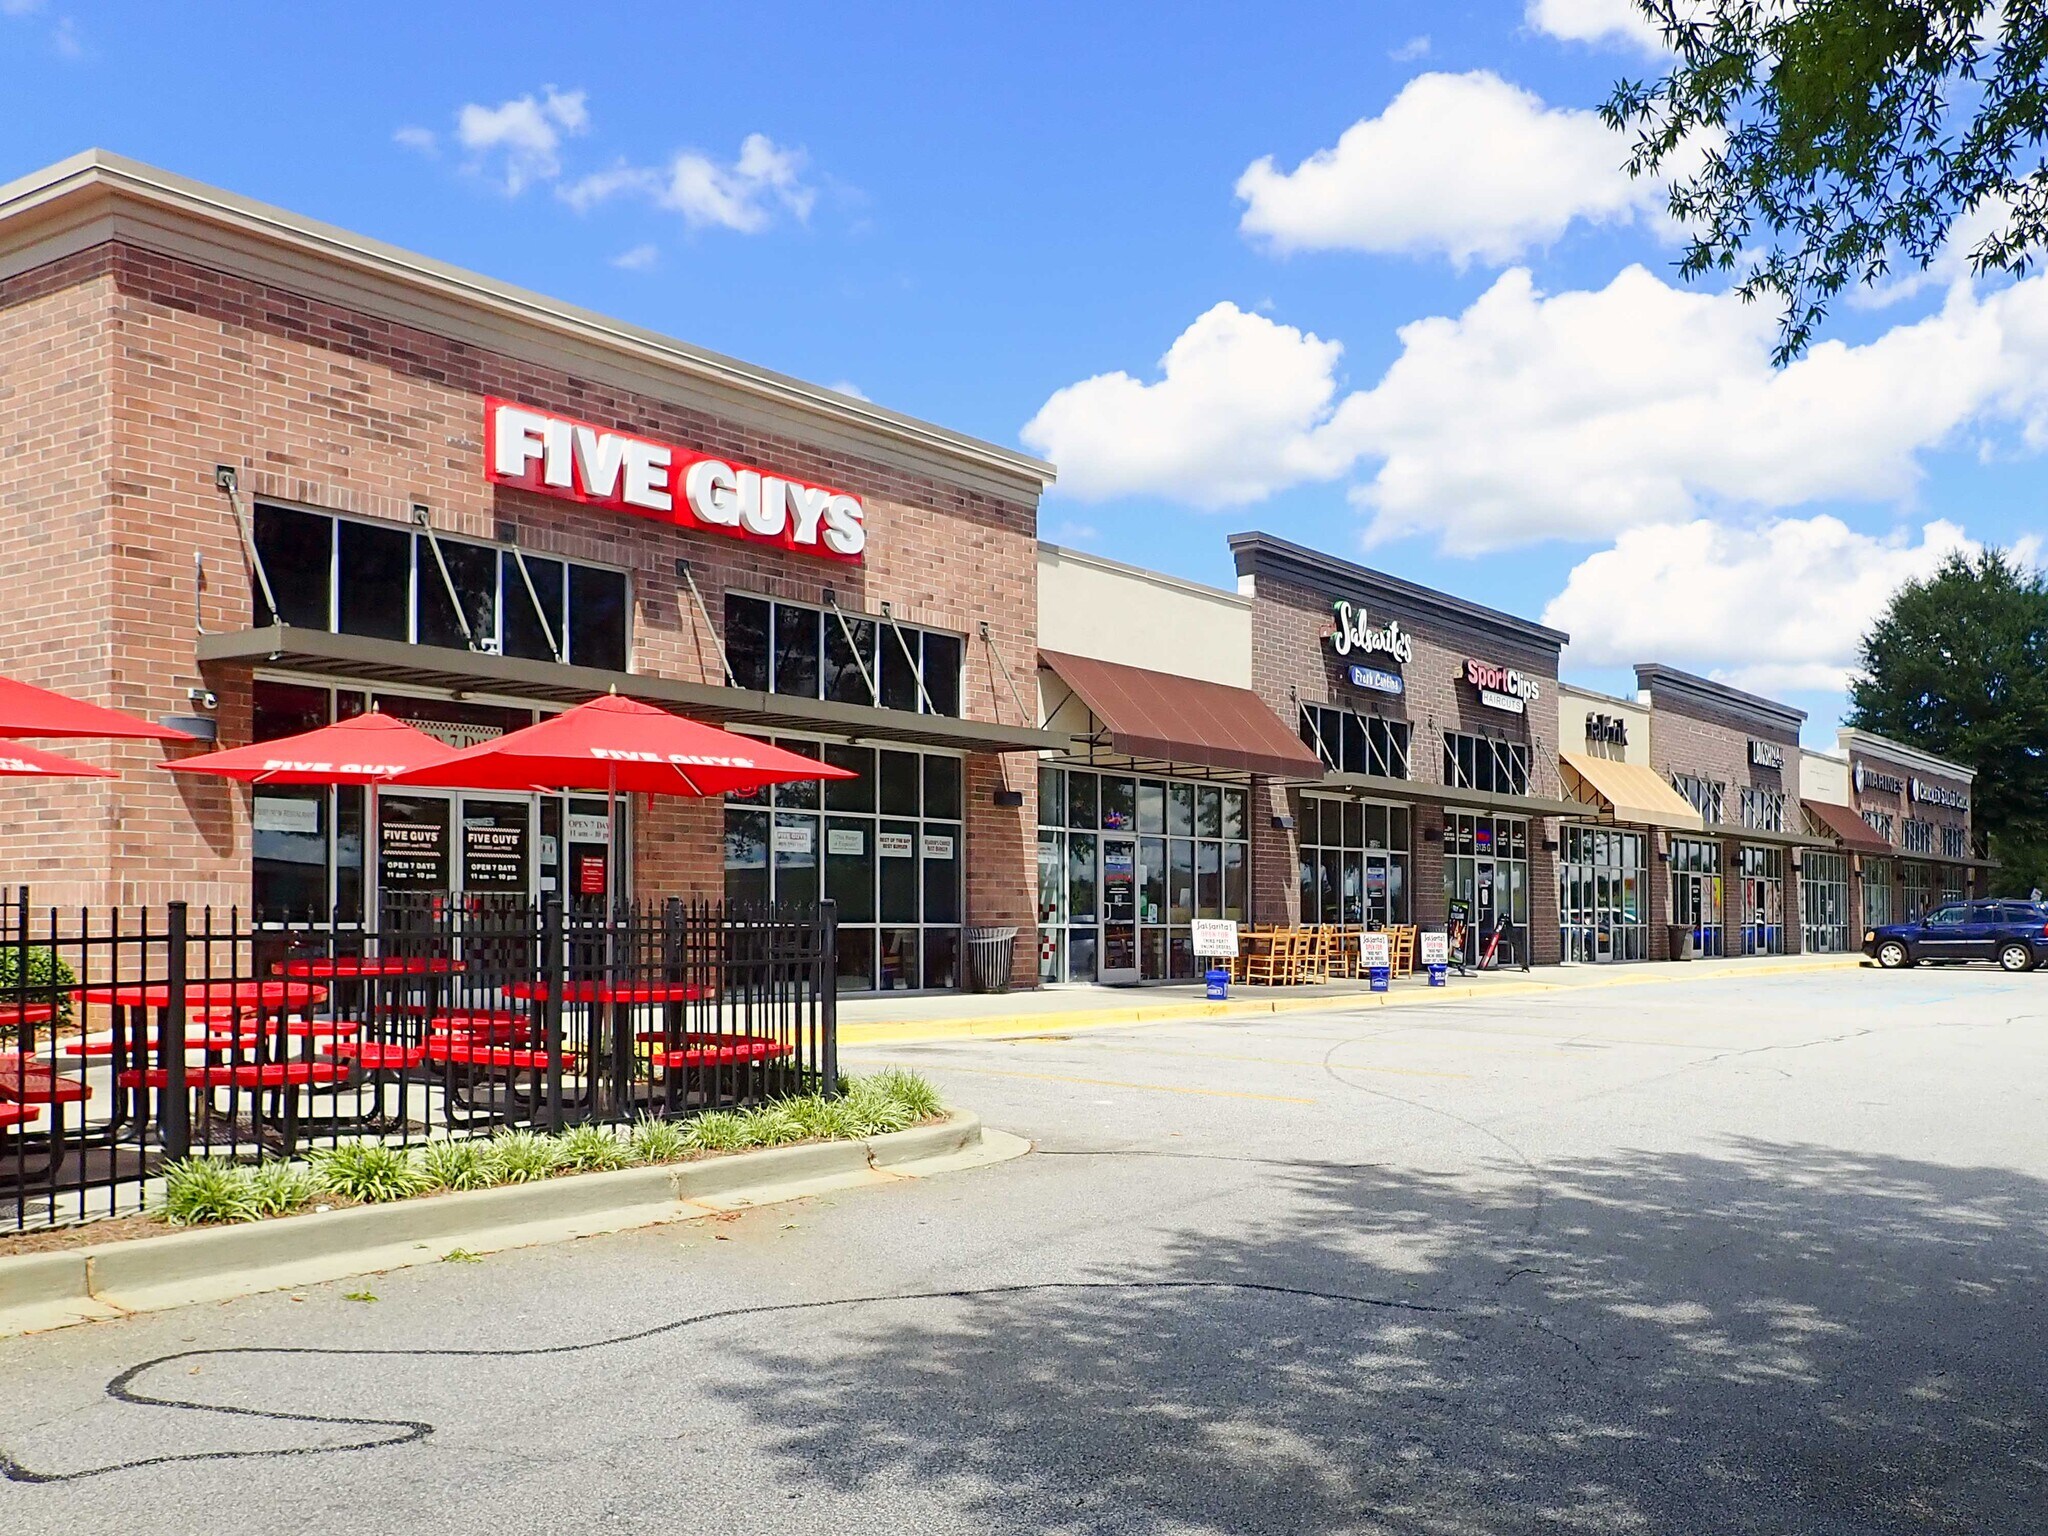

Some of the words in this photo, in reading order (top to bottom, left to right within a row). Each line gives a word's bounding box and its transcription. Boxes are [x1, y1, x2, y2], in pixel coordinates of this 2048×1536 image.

[495, 405, 672, 511] FIVE
[686, 460, 866, 555] GUYS
[1334, 601, 1412, 663] Salsarita's
[1355, 668, 1374, 686] Fresh
[1375, 673, 1399, 691] Cantina
[1483, 693, 1522, 711] HAIRCUTS
[591, 748, 664, 762] FIVE
[668, 754, 756, 768] GUYS
[263, 760, 333, 771] FIVE
[340, 763, 407, 774] GUY
[1864, 769, 1904, 794] MARINES
[568, 820, 589, 828] OPEN
[597, 821, 609, 830] DAY
[384, 830, 408, 841] FIVE
[410, 831, 438, 842] GUYS
[468, 833, 490, 843] FIVE
[492, 834, 518, 845] GUYS
[387, 861, 409, 869] OPEN
[416, 862, 436, 870] DAYS
[471, 863, 491, 871] OPEN
[498, 864, 517, 872] DAYS
[426, 872, 437, 880] pm
